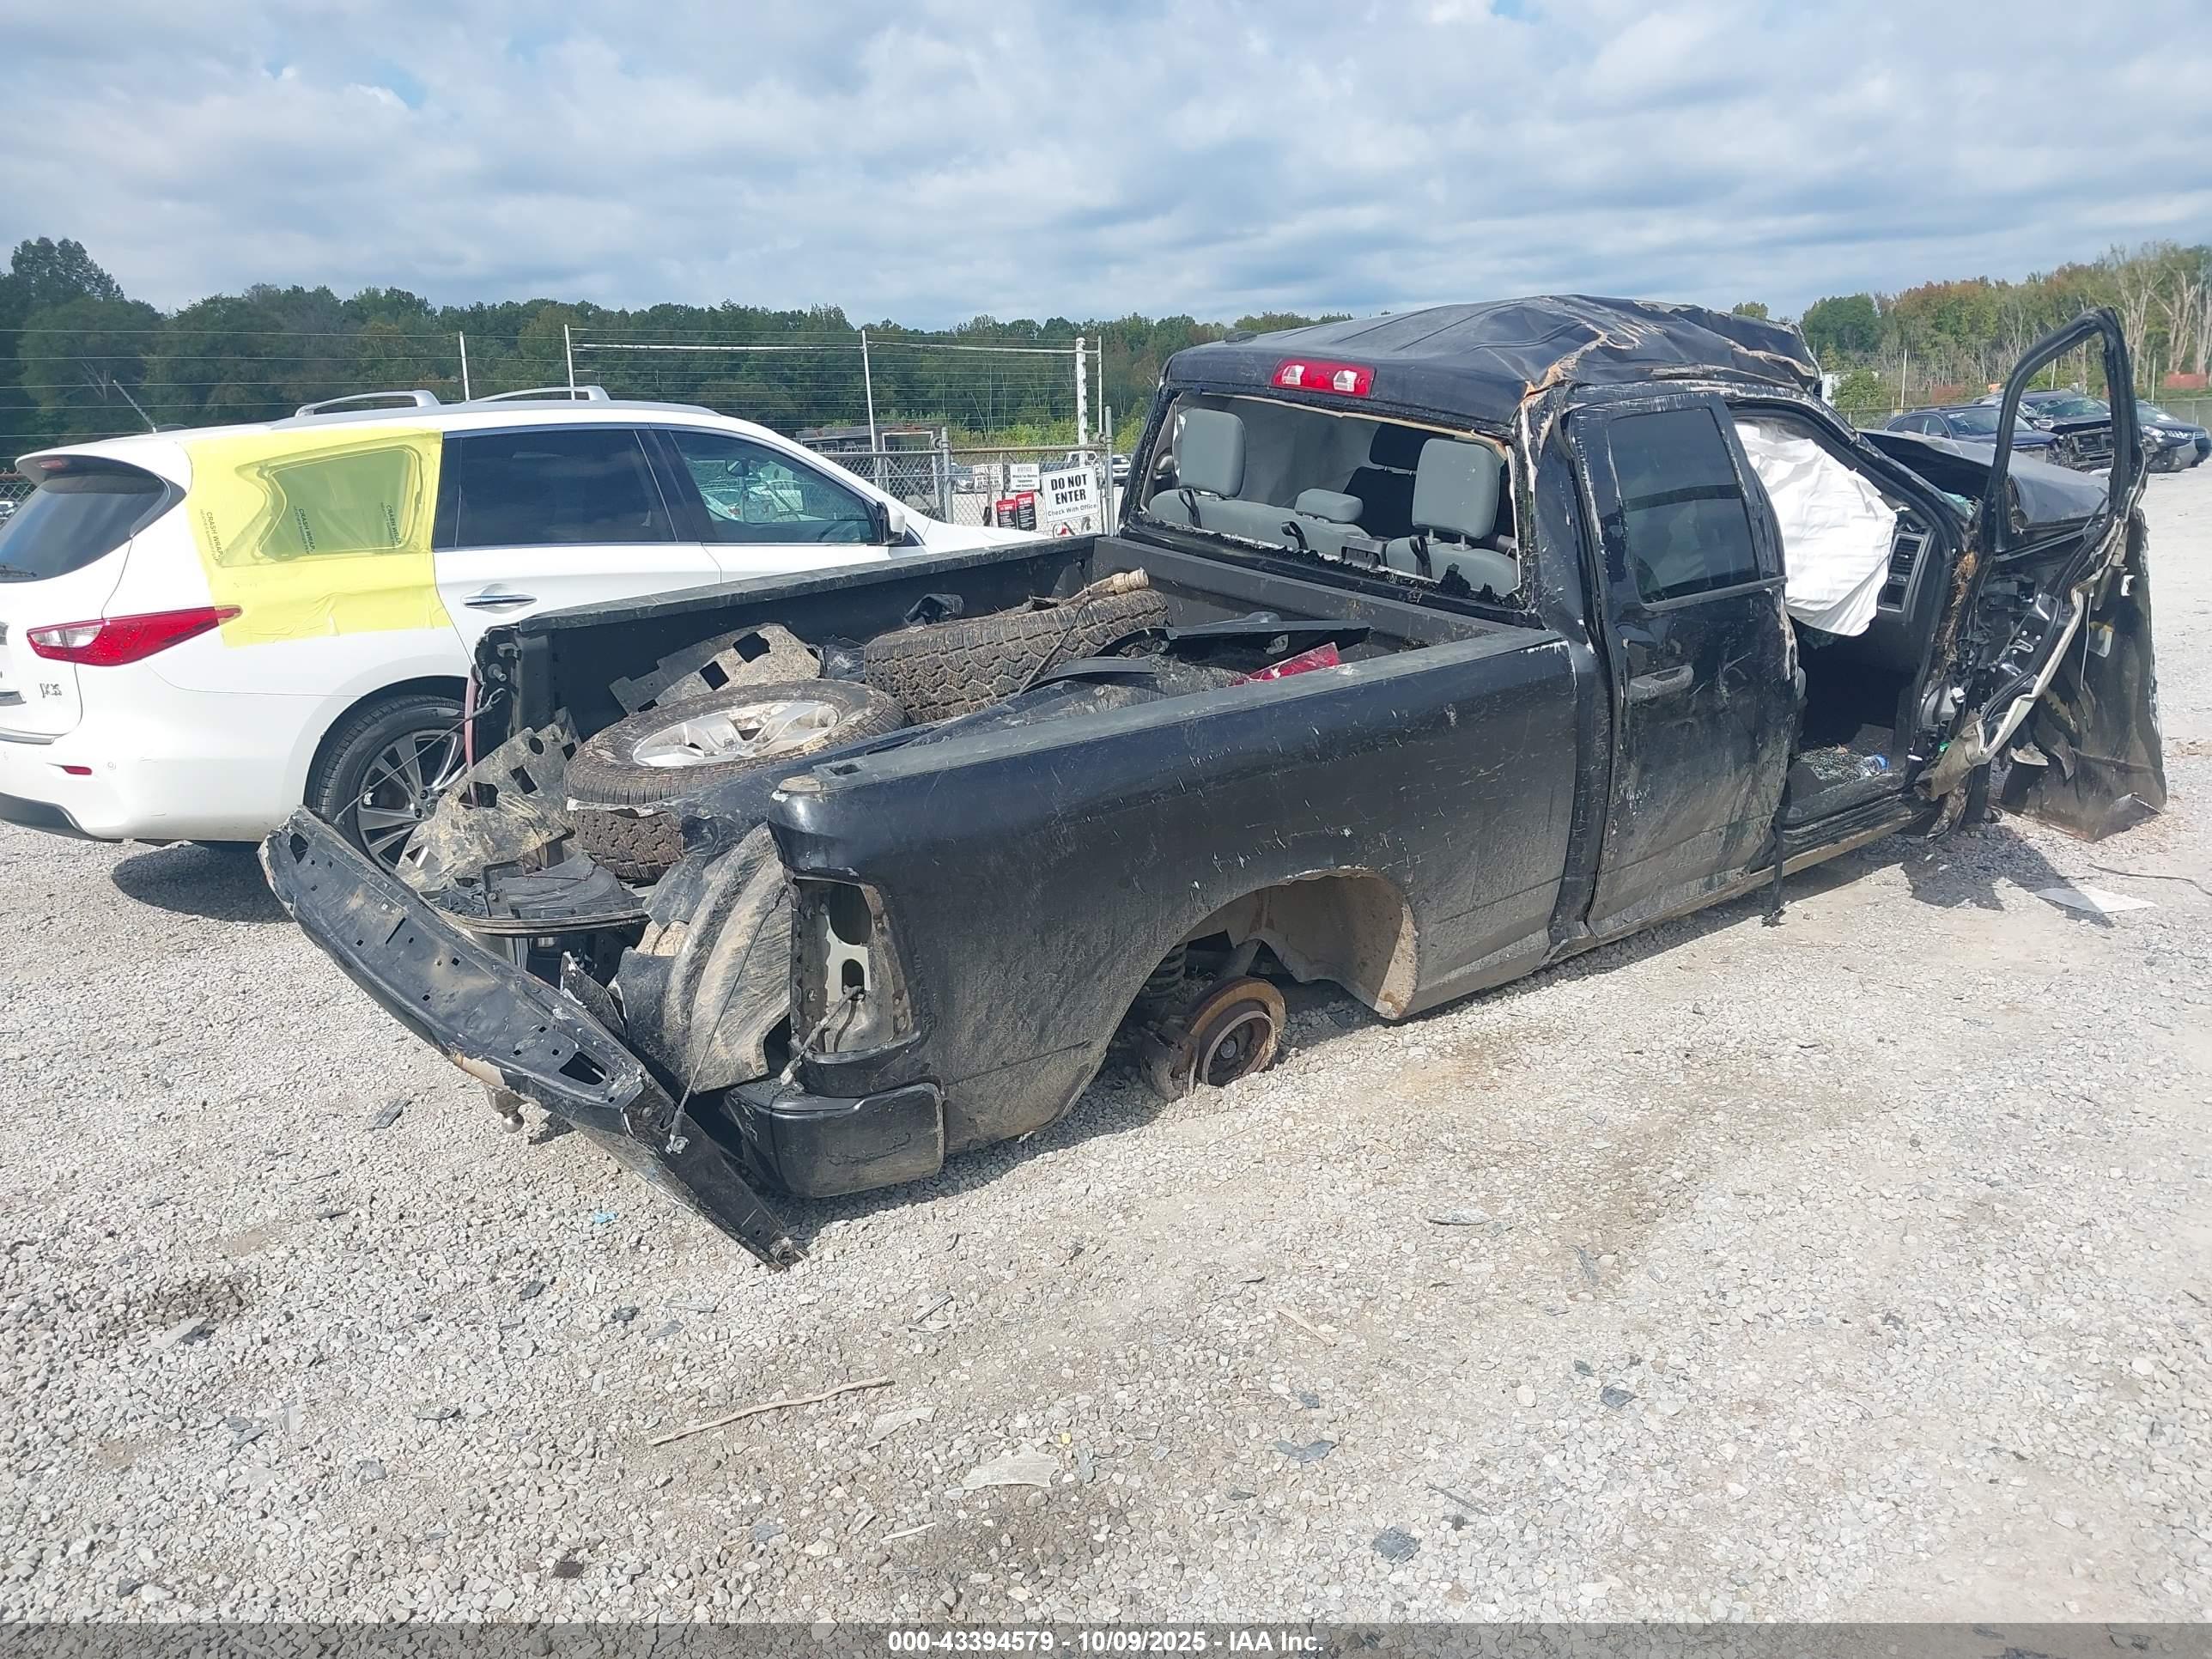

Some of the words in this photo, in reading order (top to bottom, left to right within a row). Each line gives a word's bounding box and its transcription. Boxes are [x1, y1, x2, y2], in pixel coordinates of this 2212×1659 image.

[1050, 477, 1066, 491] DO
[1067, 473, 1088, 489] NOT
[1054, 489, 1086, 505] ENTER
[1048, 508, 1066, 517] Check
[206, 511, 218, 535] CRASH
